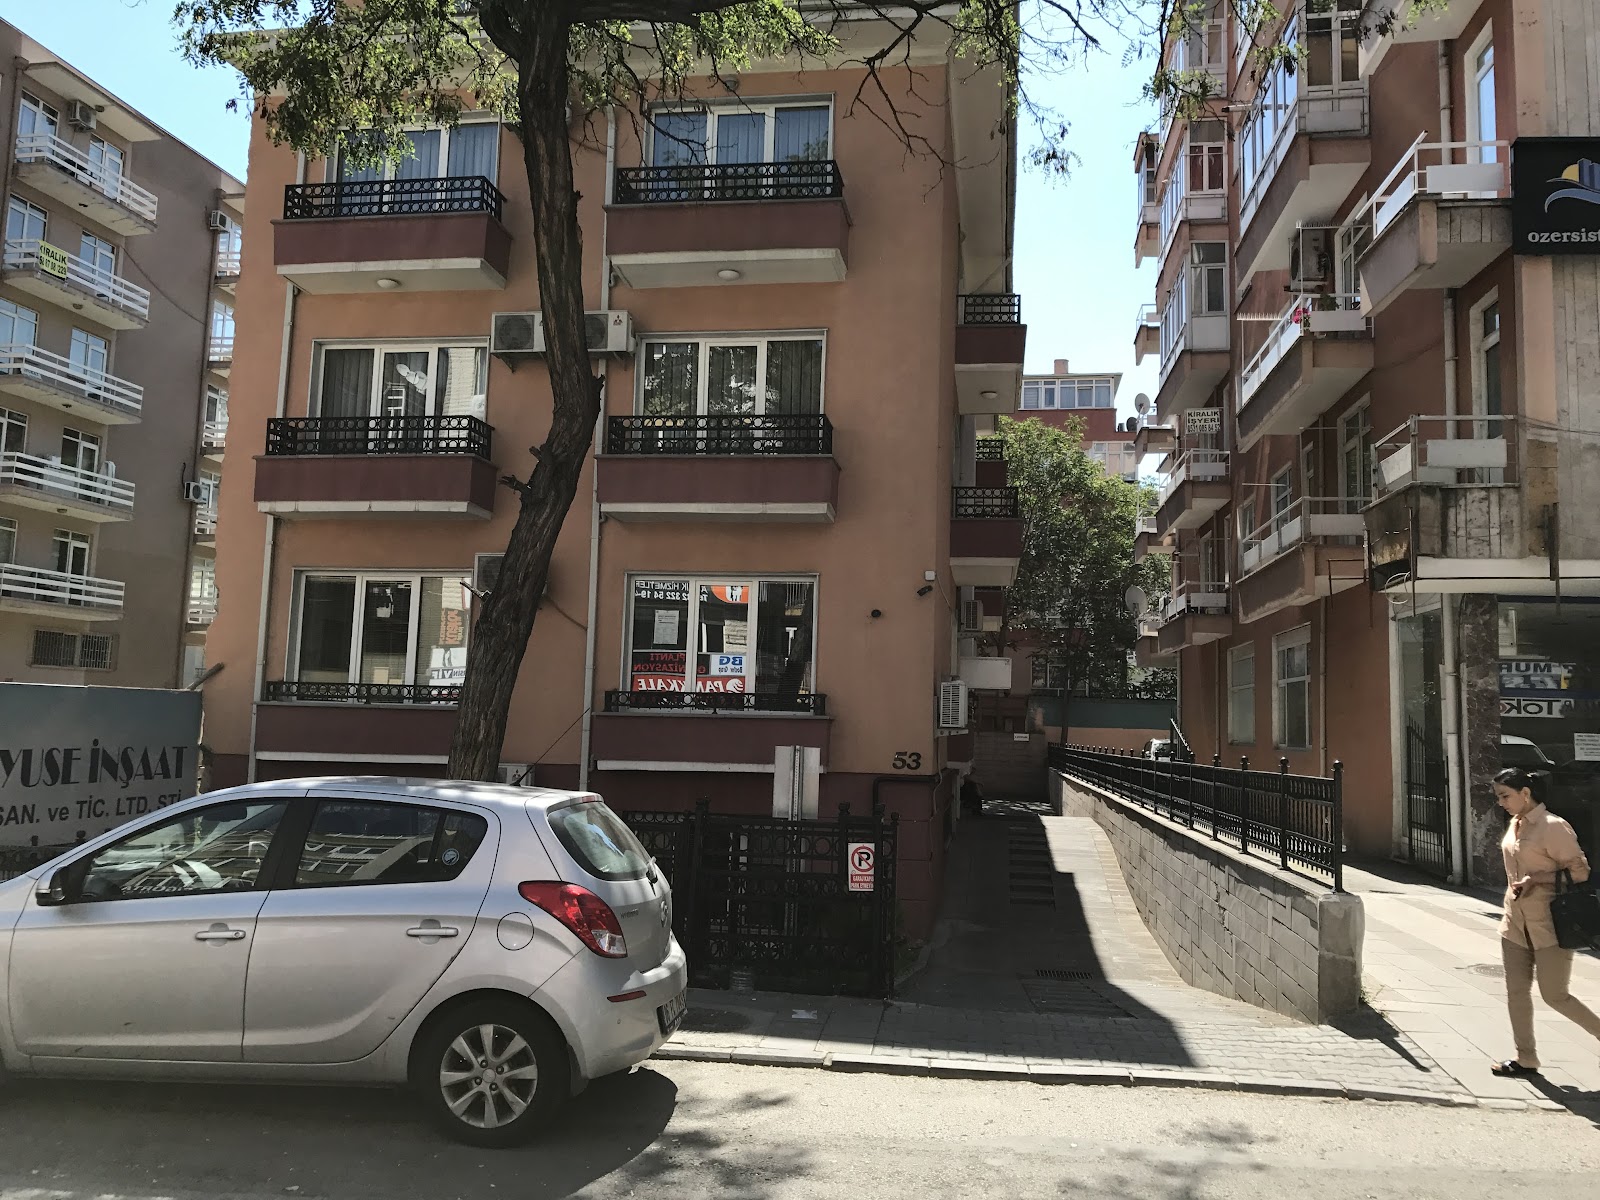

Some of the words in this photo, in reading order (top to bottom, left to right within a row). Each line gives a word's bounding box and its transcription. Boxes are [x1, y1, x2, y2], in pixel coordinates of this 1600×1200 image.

[88, 738, 188, 789] İNŞAAT
[892, 751, 922, 770] 53
[48, 805, 70, 821] ve
